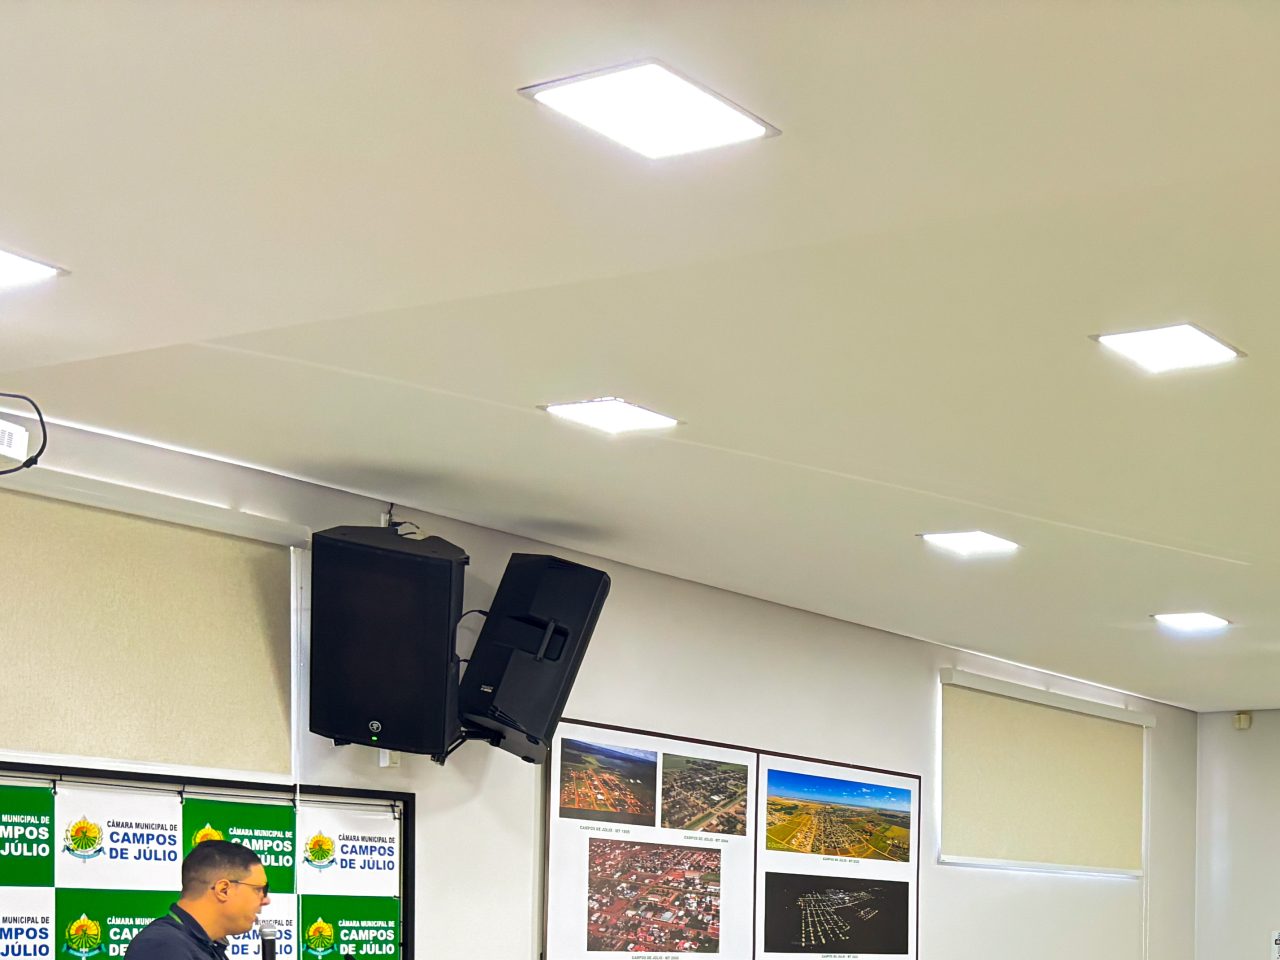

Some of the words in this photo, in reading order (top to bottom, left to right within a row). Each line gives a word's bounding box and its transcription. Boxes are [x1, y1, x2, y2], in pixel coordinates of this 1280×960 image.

[2, 814, 39, 824] MUNICIPAL
[41, 816, 50, 824] DE
[107, 820, 134, 830] CÂMARA
[134, 823, 168, 831] MUNICIPAL
[0, 826, 49, 840] MPOS
[109, 832, 177, 846] CAMPOS
[254, 829, 284, 838] MUNICIPAL
[109, 848, 128, 860] DE
[134, 847, 178, 862] JÚLIO
[340, 844, 394, 856] CAMPOS
[257, 852, 292, 866] ÚLIO
[340, 858, 356, 869] DE
[360, 857, 394, 870] JÚLIO
[106, 916, 133, 925] CÂMARA
[0, 928, 49, 940] MPOS
[340, 930, 394, 940] CAMPOS
[0, 942, 50, 956] JÚLIO
[232, 944, 248, 955] DE
[340, 944, 356, 954] DE
[360, 942, 394, 954] JÚLIO
